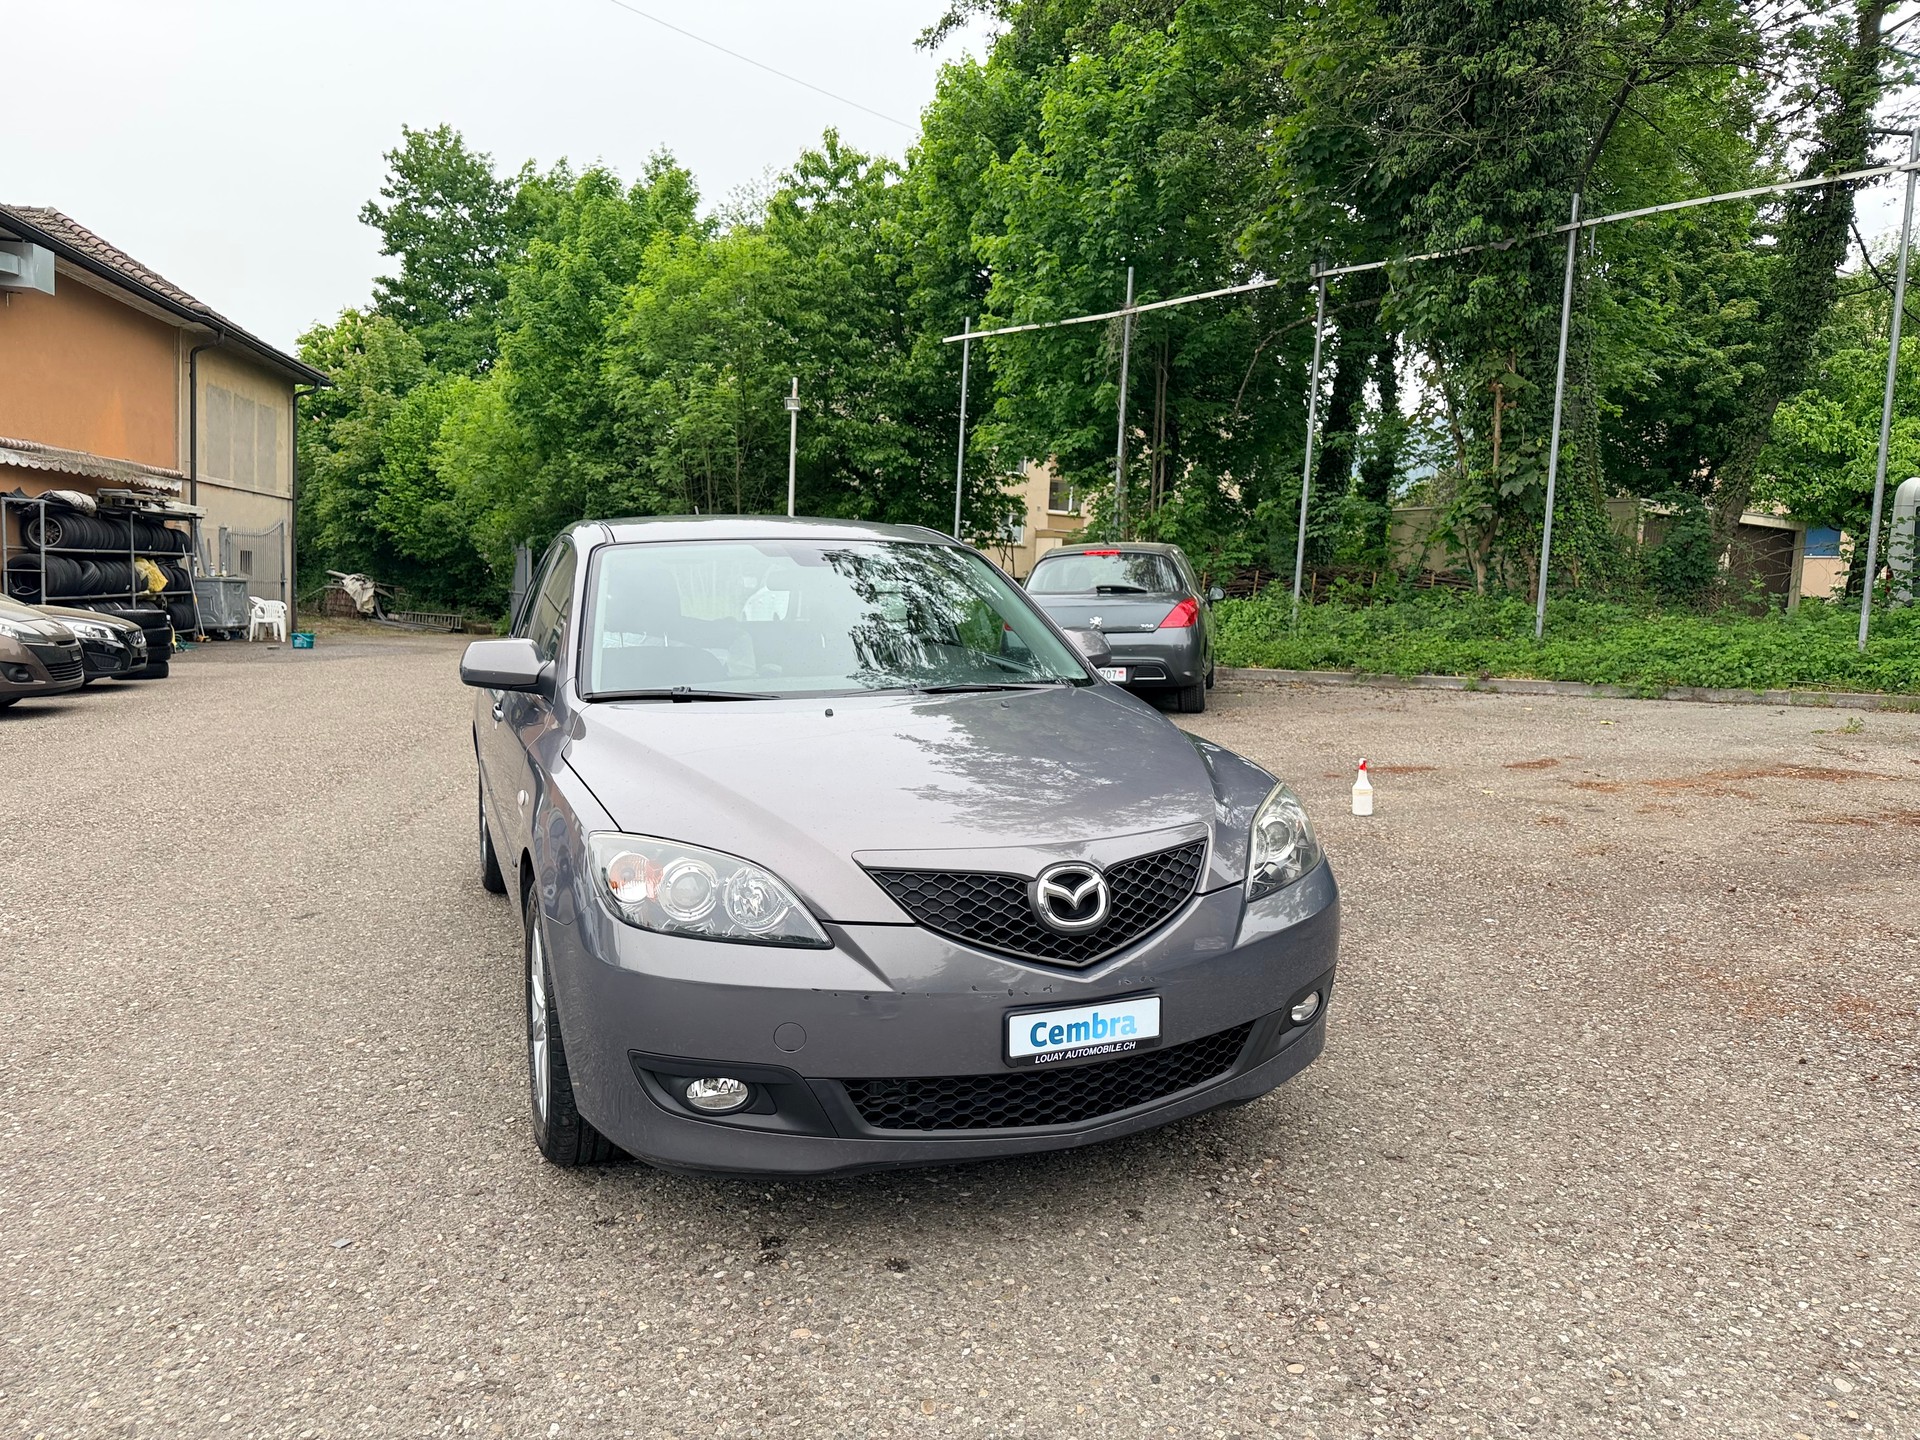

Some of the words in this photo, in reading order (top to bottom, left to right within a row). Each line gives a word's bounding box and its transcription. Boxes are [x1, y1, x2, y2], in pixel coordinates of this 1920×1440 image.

[1030, 1012, 1138, 1047] Cembra
[1035, 1052, 1064, 1064] LOUAY
[1065, 1041, 1136, 1059] AUTOMOBILE.CH
